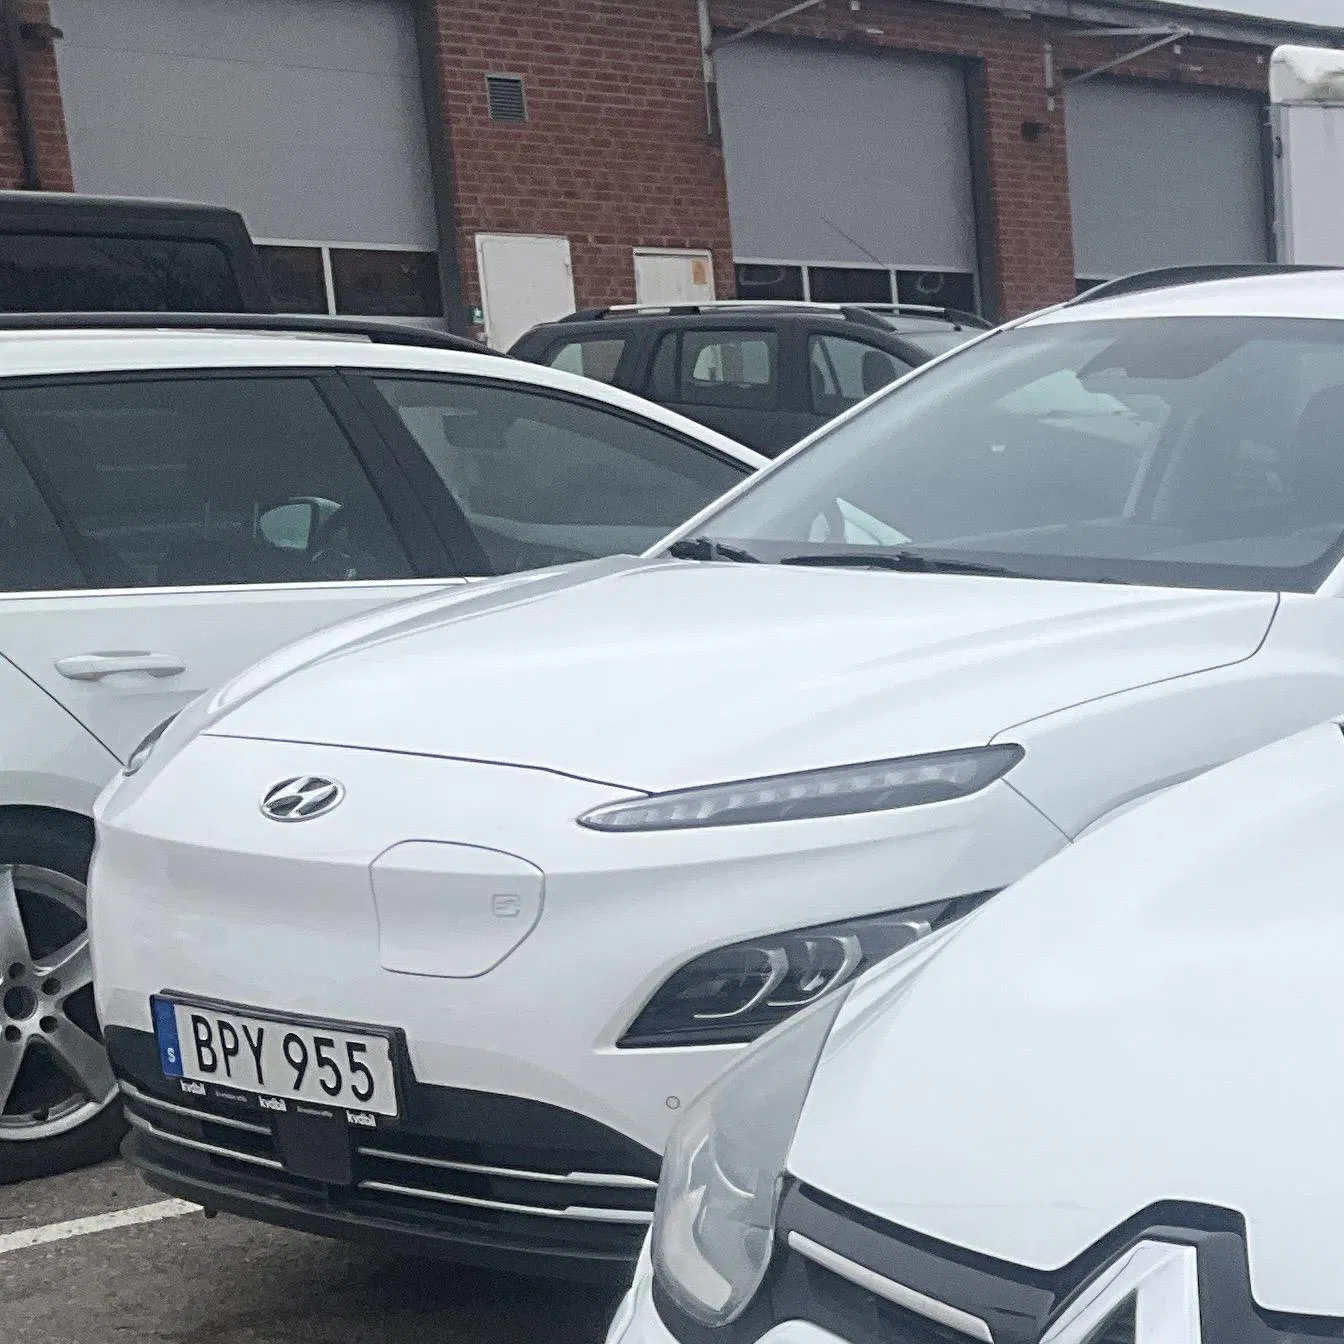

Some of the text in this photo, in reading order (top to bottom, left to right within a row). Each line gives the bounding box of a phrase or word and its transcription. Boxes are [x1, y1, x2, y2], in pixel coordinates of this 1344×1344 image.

[166, 1046, 177, 1064] S
[190, 1014, 375, 1102] BPY 955
